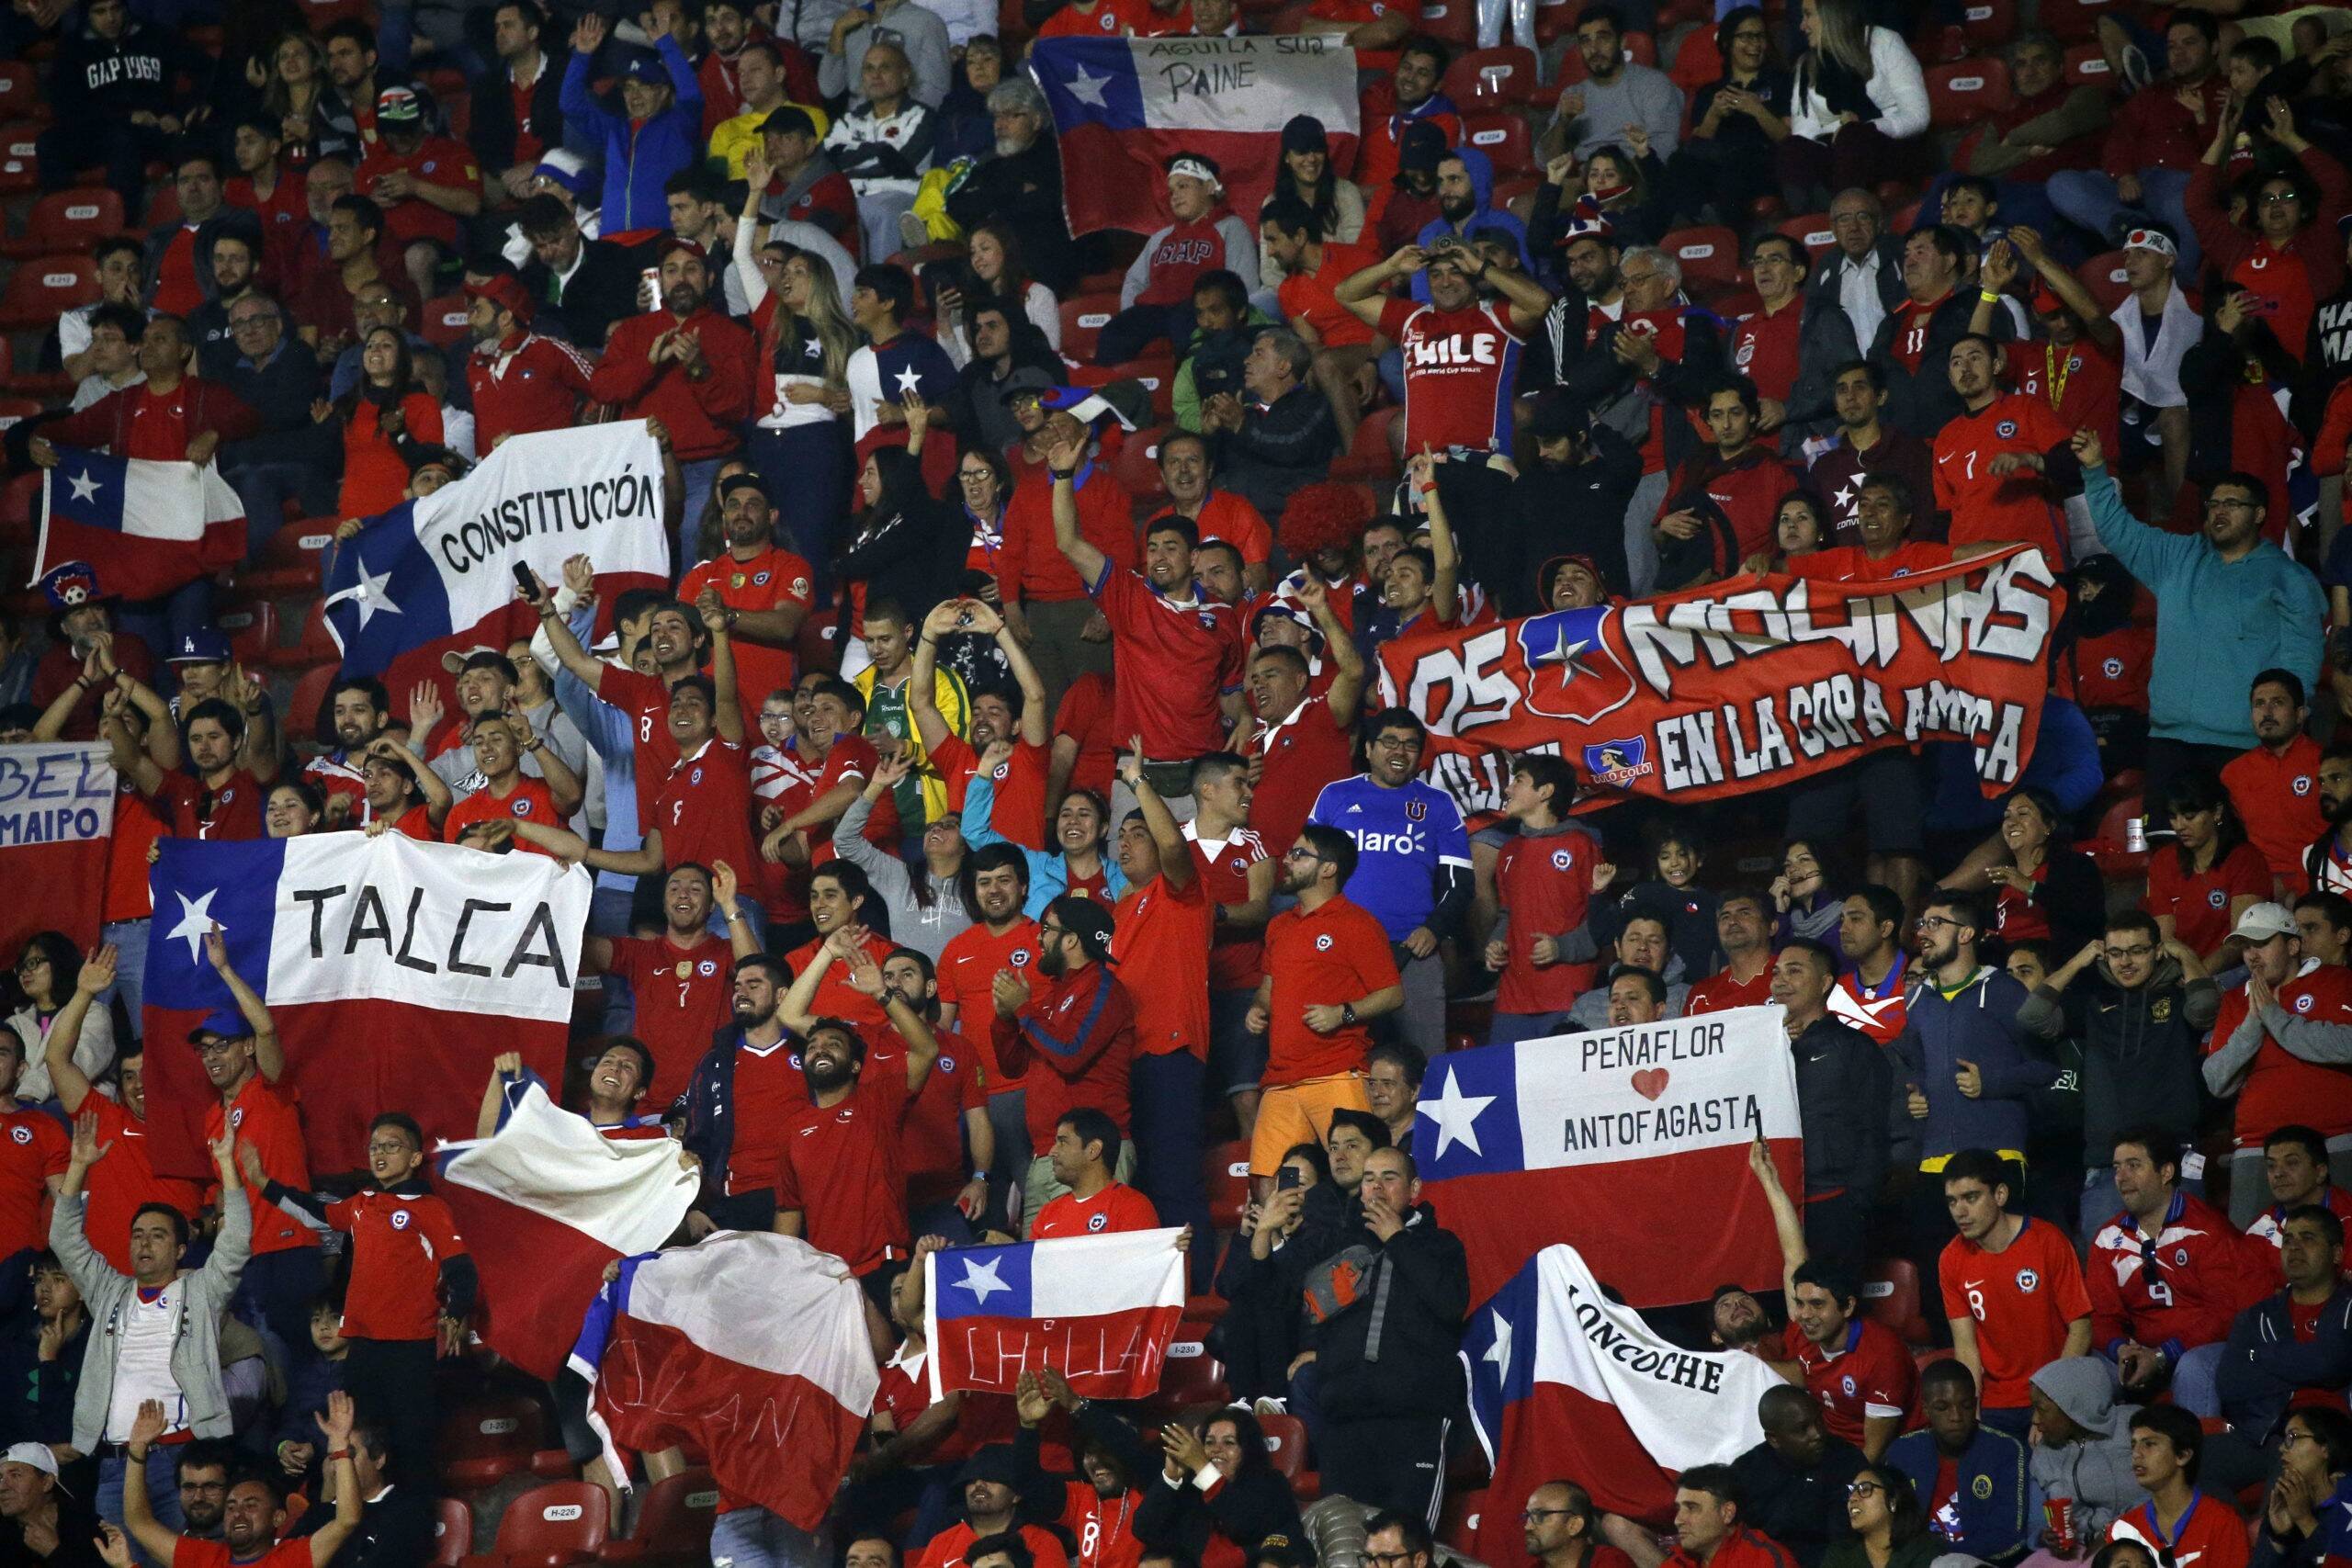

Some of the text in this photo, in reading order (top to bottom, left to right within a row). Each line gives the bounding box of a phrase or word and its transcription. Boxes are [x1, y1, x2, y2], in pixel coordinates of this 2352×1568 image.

[1148, 38, 1324, 57] AGUILA SUR
[86, 54, 161, 90] GAP 1969
[1159, 61, 1256, 103] PAINE
[1154, 240, 1214, 266] GAP
[1405, 332, 1497, 367] HILE
[1964, 450, 1977, 480] 7
[441, 464, 657, 574] CONSTITUCIÓN
[1623, 548, 2057, 701] MOLINAS
[640, 715, 653, 744] 8
[1656, 710, 1725, 791] EN
[1724, 694, 1795, 779] LA
[0, 807, 100, 846] MAIPO
[293, 884, 571, 989] TALCA
[678, 981, 691, 1008] 7
[1581, 1021, 1724, 1073] PEÑAFLOR
[1564, 1093, 1758, 1153] ANTOFAGASTA
[1968, 1289, 1986, 1323] 8
[550, 1507, 577, 1517] H-226
[1081, 1520, 1100, 1558] 8
